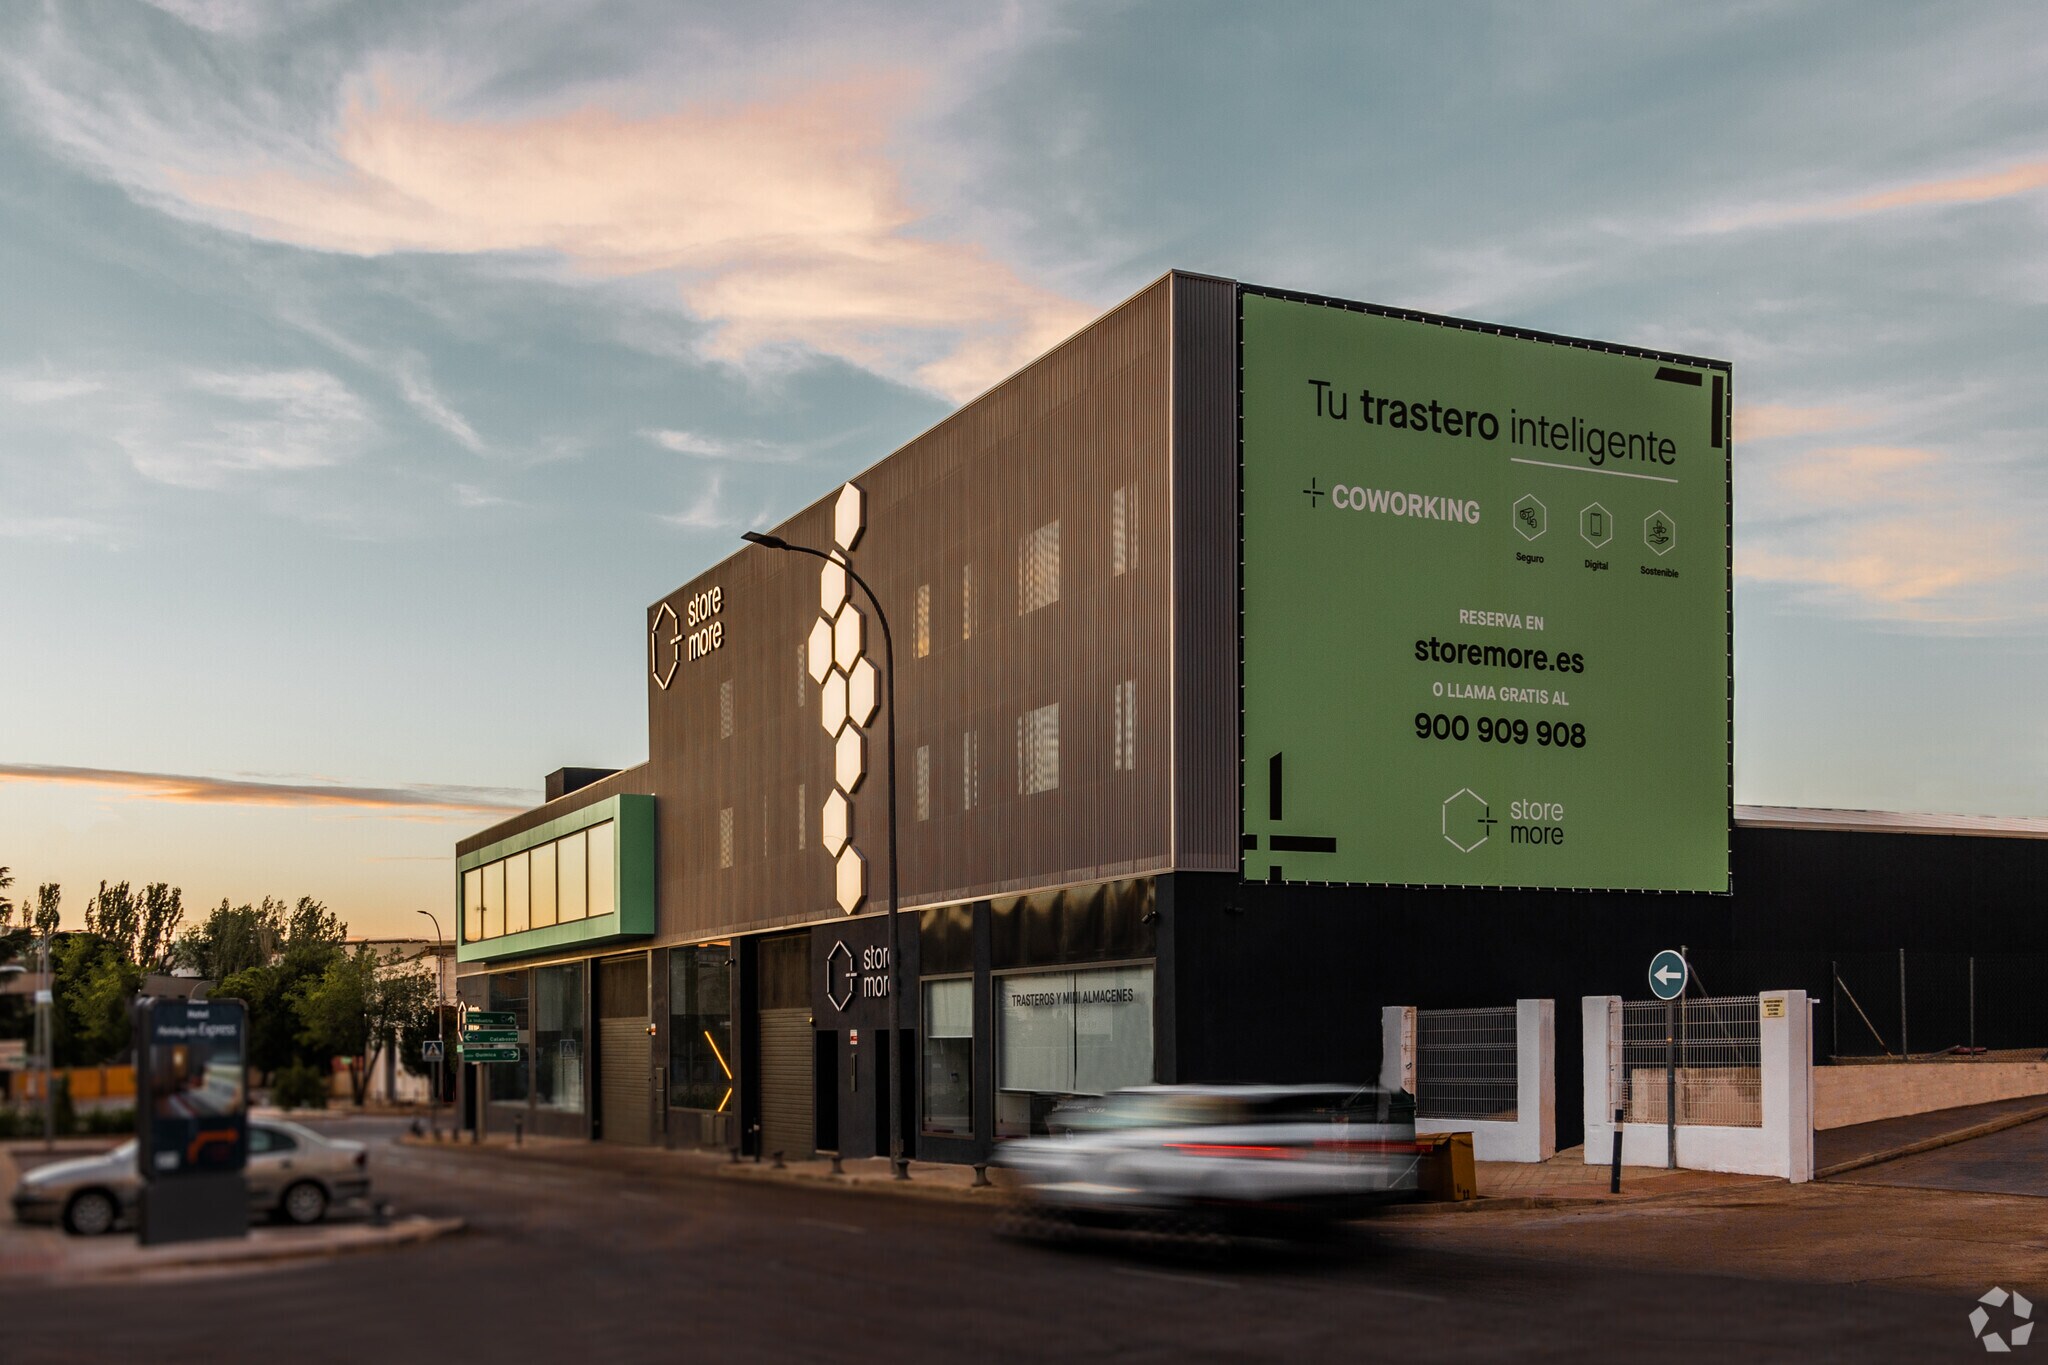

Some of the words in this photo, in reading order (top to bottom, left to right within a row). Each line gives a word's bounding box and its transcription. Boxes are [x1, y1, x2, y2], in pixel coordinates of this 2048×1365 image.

[1308, 379, 1347, 420] Tu
[1360, 389, 1500, 441] trastero
[1511, 408, 1677, 466] inteligente
[1332, 484, 1481, 525] COWORKING
[1516, 552, 1544, 564] Seguro
[1584, 559, 1609, 571] Digital
[1640, 566, 1679, 578] Sostenible
[688, 586, 721, 627] store
[1459, 609, 1522, 629] RESERVA
[1526, 615, 1544, 631] EN
[688, 621, 722, 661] more
[1415, 637, 1584, 673] storemore.es
[1432, 682, 1443, 696] O
[1447, 683, 1496, 700] LLAMA
[1500, 687, 1549, 705] GRATIS
[1552, 691, 1570, 706] AL
[1415, 713, 1469, 741] 900
[1477, 717, 1529, 744] 909
[1536, 721, 1586, 748] 908
[1511, 799, 1564, 822] store
[1511, 824, 1564, 845] more
[1012, 993, 1055, 1006] TRASTEROS
[1056, 992, 1062, 1005] Y
[1083, 988, 1134, 1004] ALMACENES
